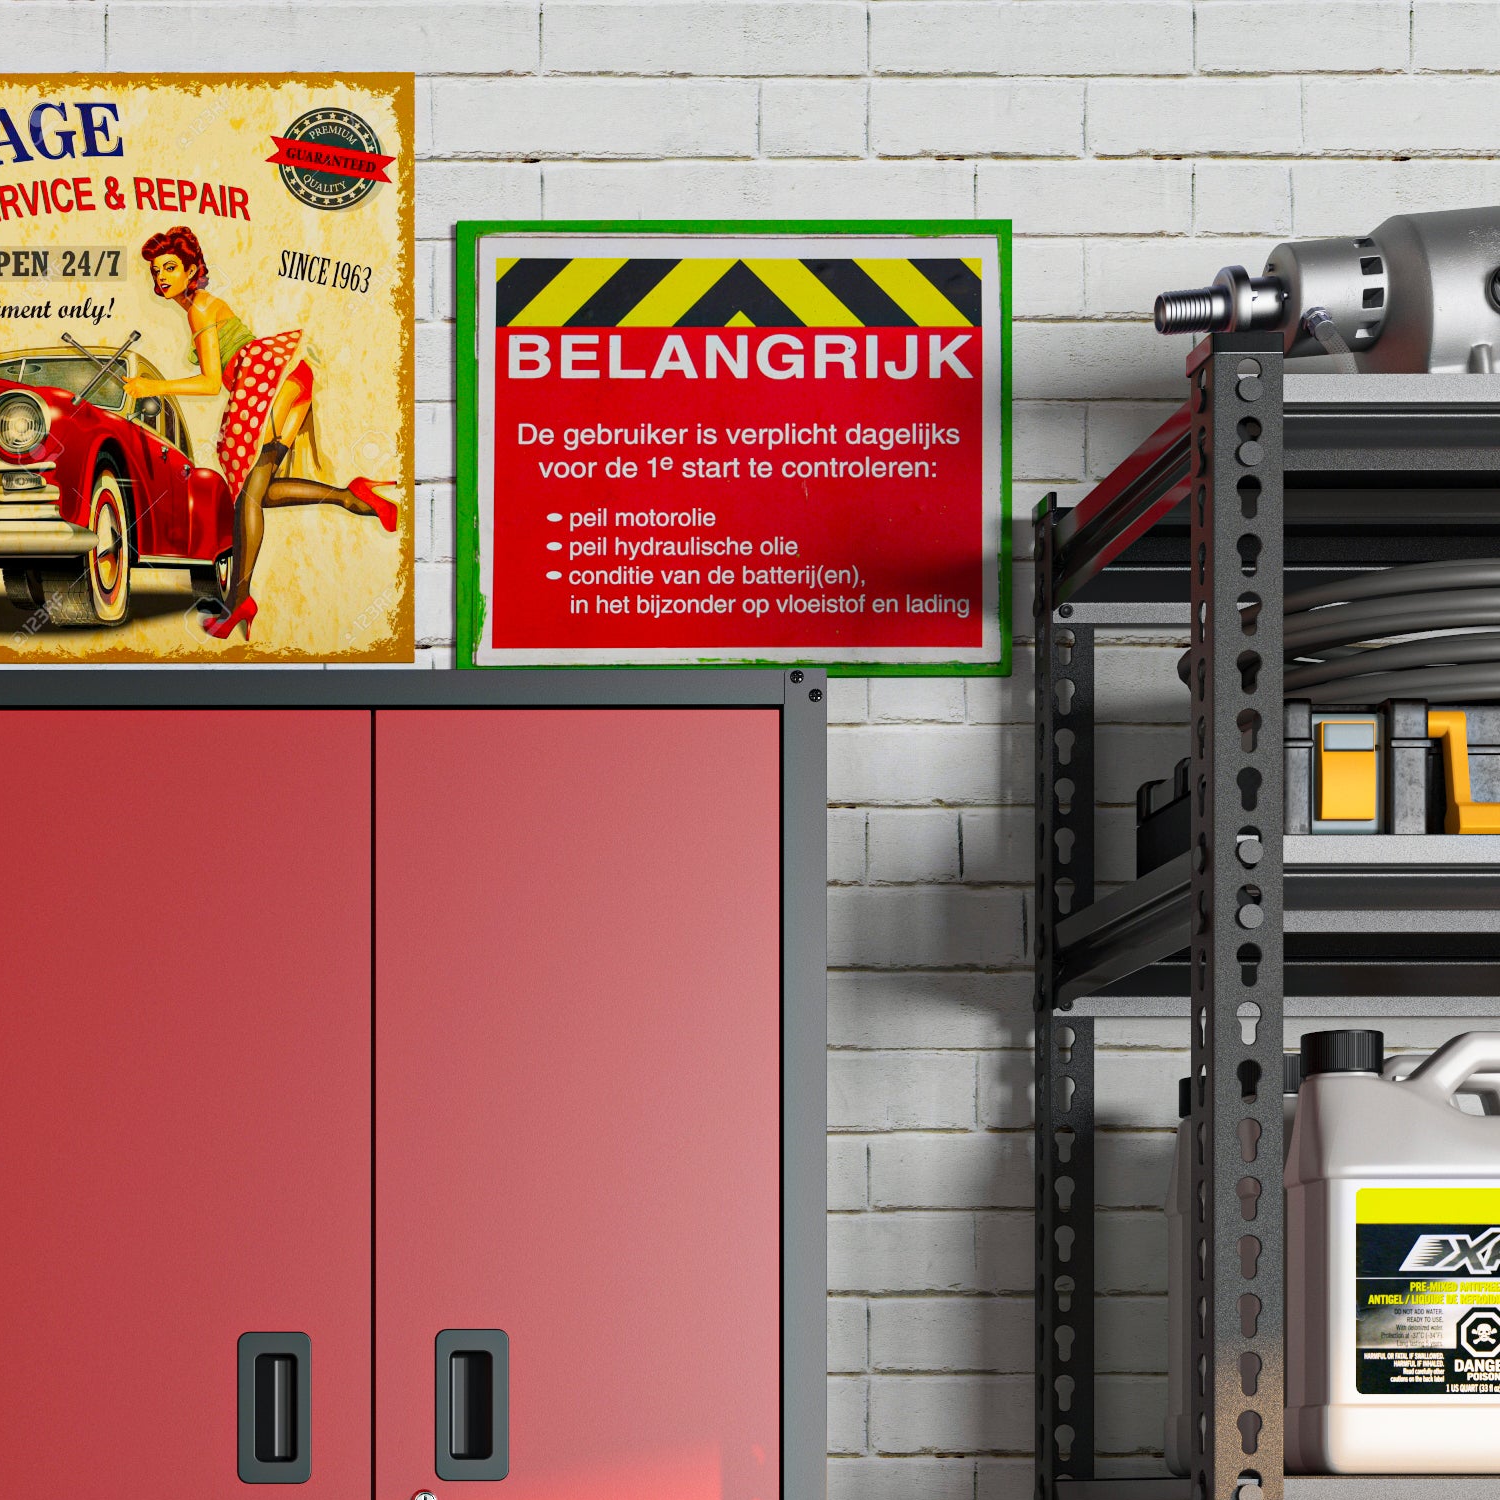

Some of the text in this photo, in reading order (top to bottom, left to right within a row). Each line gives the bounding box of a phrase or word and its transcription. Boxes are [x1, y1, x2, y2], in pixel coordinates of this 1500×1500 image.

[308, 125, 358, 146] PREMIUM
[285, 147, 377, 174] GUARANTEED
[302, 174, 347, 193] QUALITY
[104, 177, 126, 210] &
[135, 177, 252, 222] REPAIR
[62, 249, 121, 278] 24/7
[277, 249, 372, 295] SINCE 1963
[57, 296, 115, 324] only!
[507, 334, 974, 380] BELANGRIJK
[518, 423, 961, 450] De gebruiker is verplicht dagelijks
[538, 459, 598, 478] voor
[605, 457, 637, 478] de
[682, 457, 741, 478] start
[748, 457, 773, 478] te
[781, 456, 938, 478] controleren:
[569, 508, 716, 532] peil motorolie
[569, 537, 799, 561] peil hydraulische olie
[568, 565, 866, 589] conditie van de batterij(en),
[570, 595, 971, 619] in het bijzonder op vloeistof en lading
[1368, 1294, 1403, 1305] ANTIGEL
